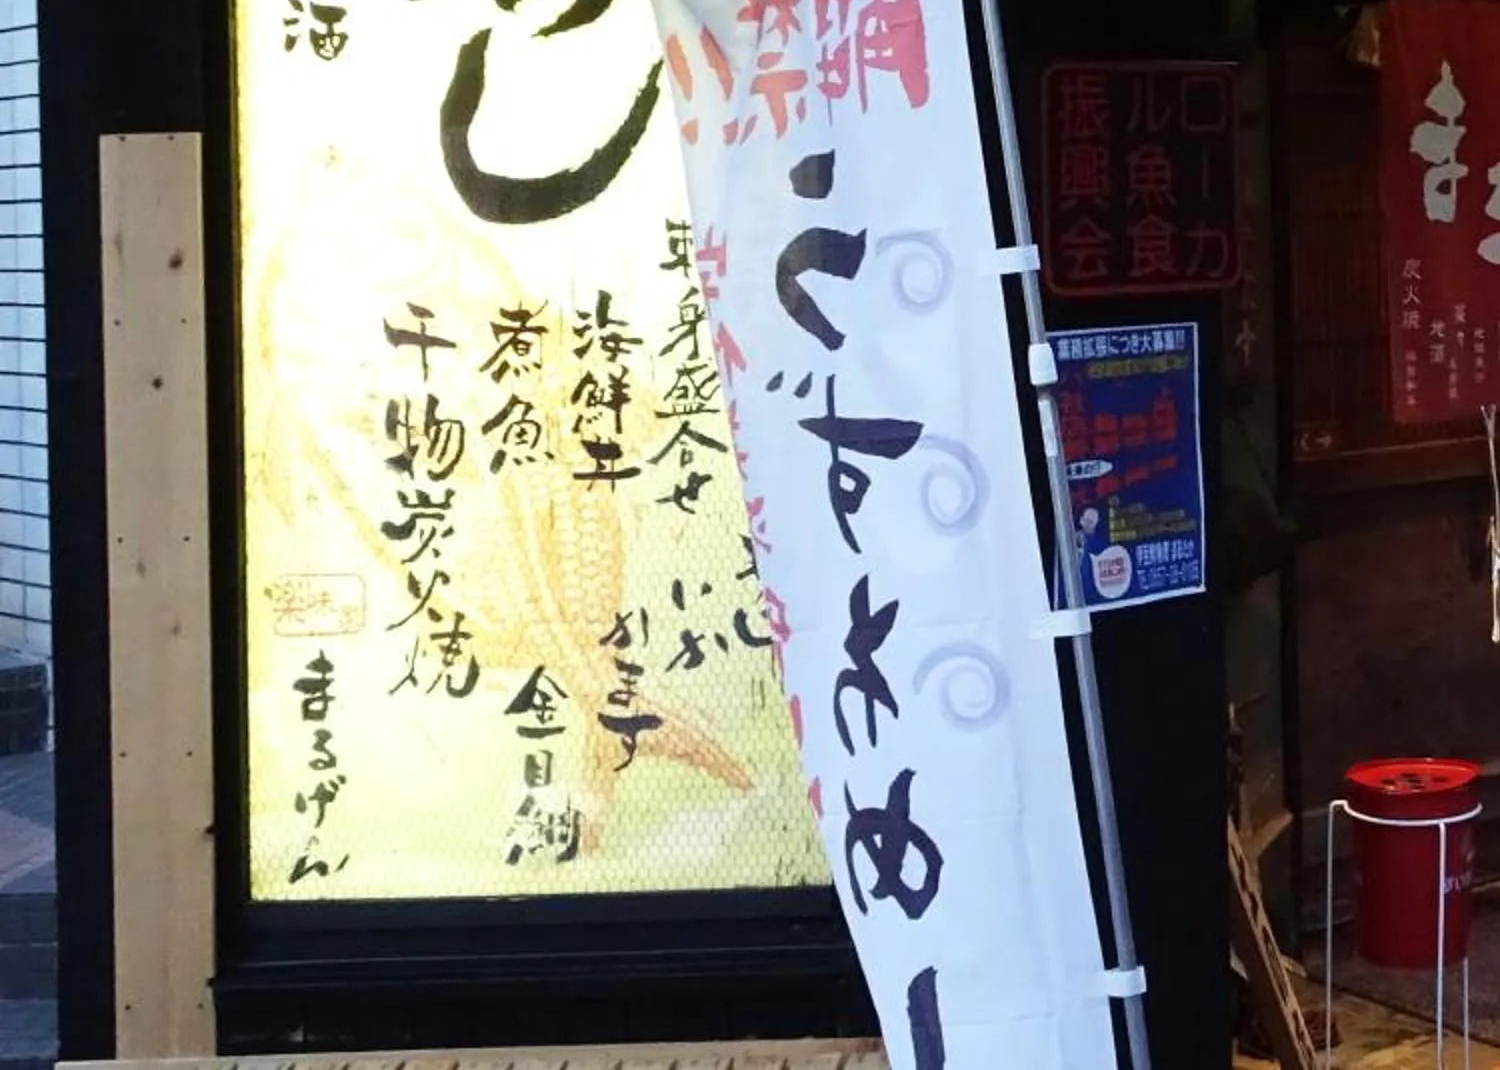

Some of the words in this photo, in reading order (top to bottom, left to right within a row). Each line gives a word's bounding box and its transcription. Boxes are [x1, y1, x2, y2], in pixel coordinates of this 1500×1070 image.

[480, 299, 554, 474] 煮魚
[381, 303, 480, 699] 干物炭火焼
[289, 648, 350, 883] まるげん
[504, 664, 580, 866] 金目鯛
